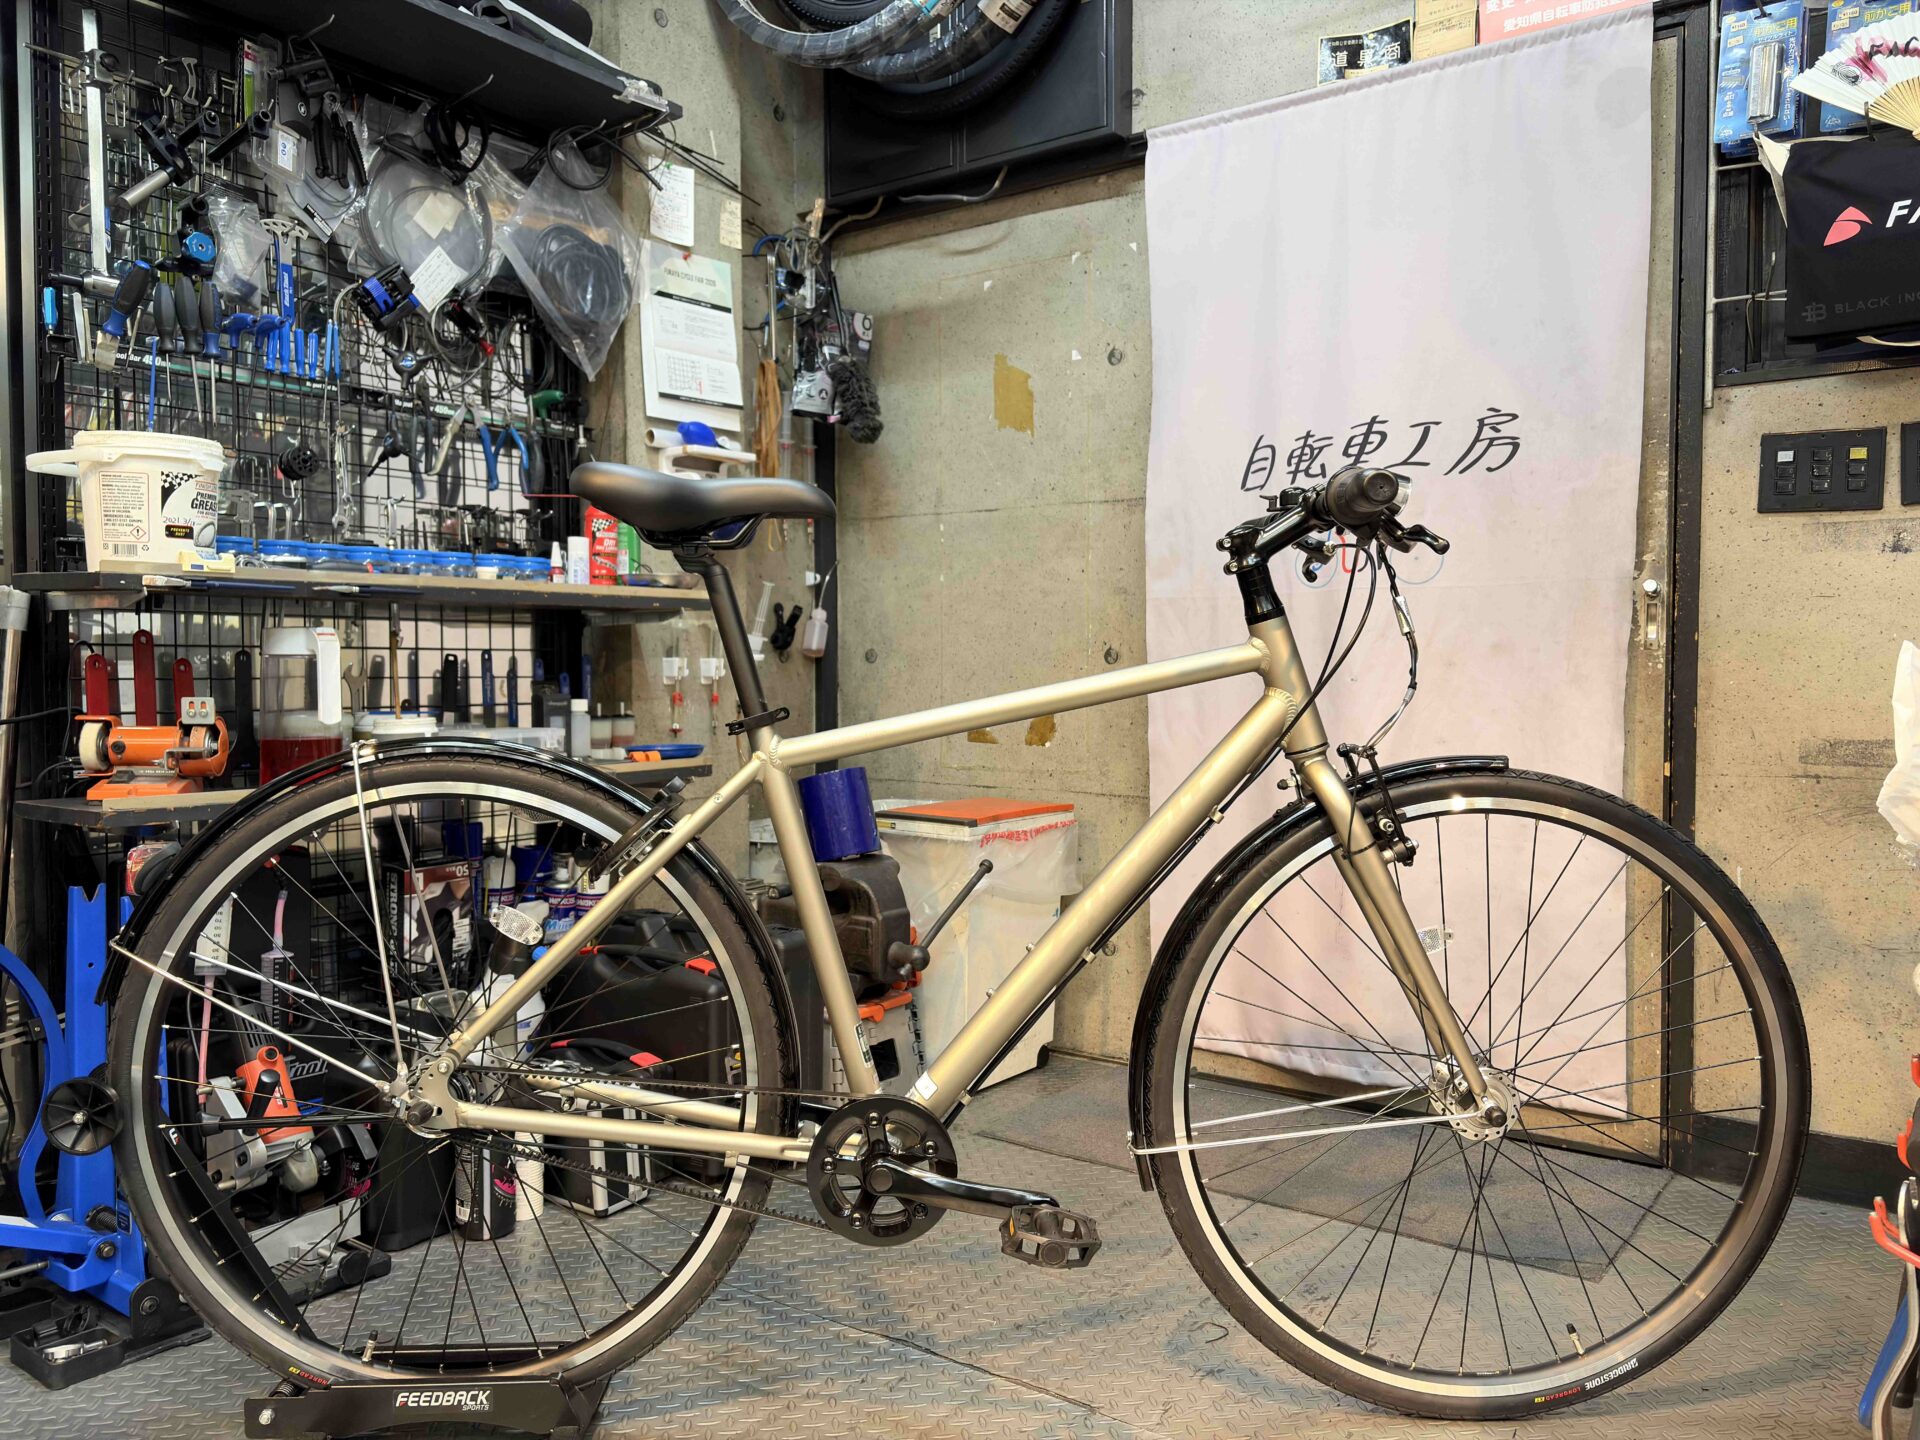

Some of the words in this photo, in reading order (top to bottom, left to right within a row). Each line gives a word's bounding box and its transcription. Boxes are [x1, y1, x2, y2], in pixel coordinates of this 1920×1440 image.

[1834, 296, 1891, 314] BLACK
[1241, 407, 1521, 492] 自転車工房
[1584, 1358, 1639, 1391] BRIDGESTONE
[395, 1390, 491, 1408] FEEDBACK
[1545, 1386, 1581, 1401] LONGREAD
